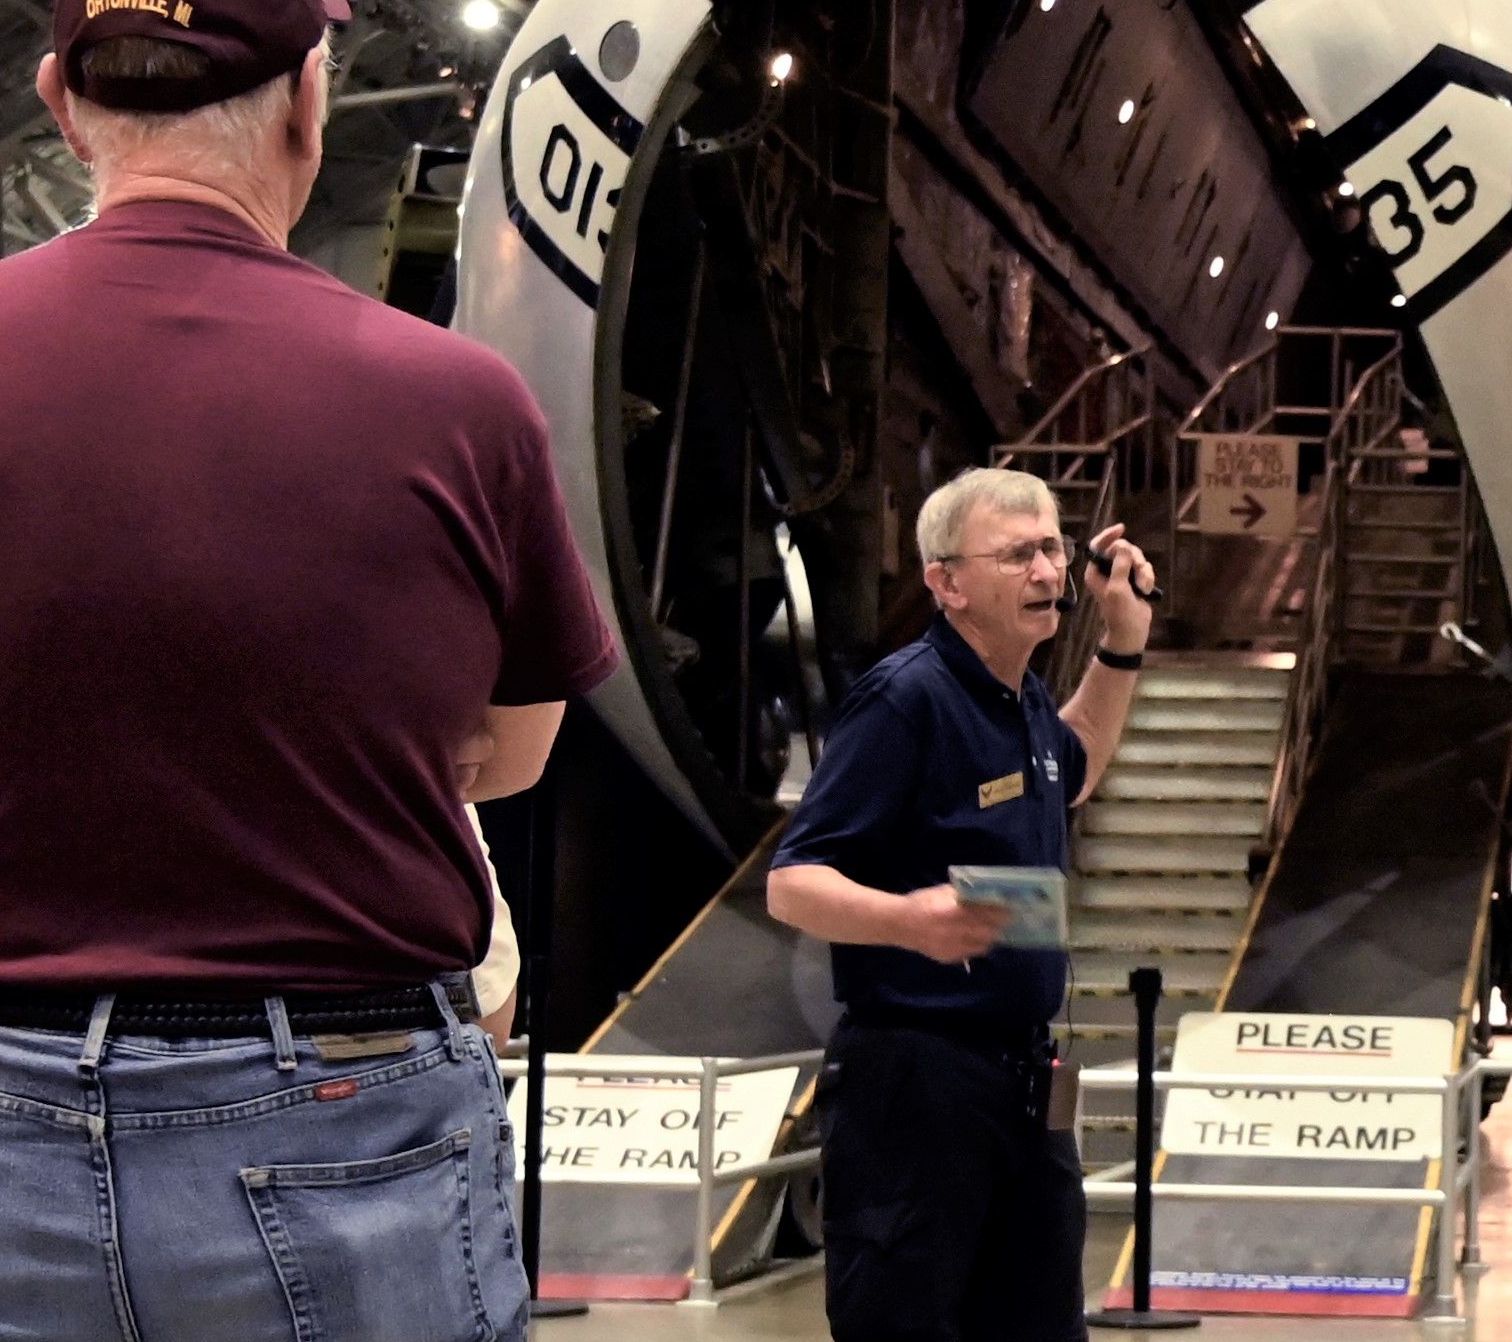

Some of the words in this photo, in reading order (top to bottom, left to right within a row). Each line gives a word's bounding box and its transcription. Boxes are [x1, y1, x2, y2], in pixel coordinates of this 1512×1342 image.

[539, 123, 622, 255] 01
[1216, 441, 1283, 458] PLEASE
[1205, 473, 1233, 488] THE
[1241, 474, 1293, 489] RIGHT
[1237, 1021, 1394, 1051] PLEASE
[544, 1106, 639, 1128] STAY
[1194, 1121, 1273, 1146] THE
[1296, 1124, 1417, 1151] RAMP
[521, 1145, 599, 1167] HE
